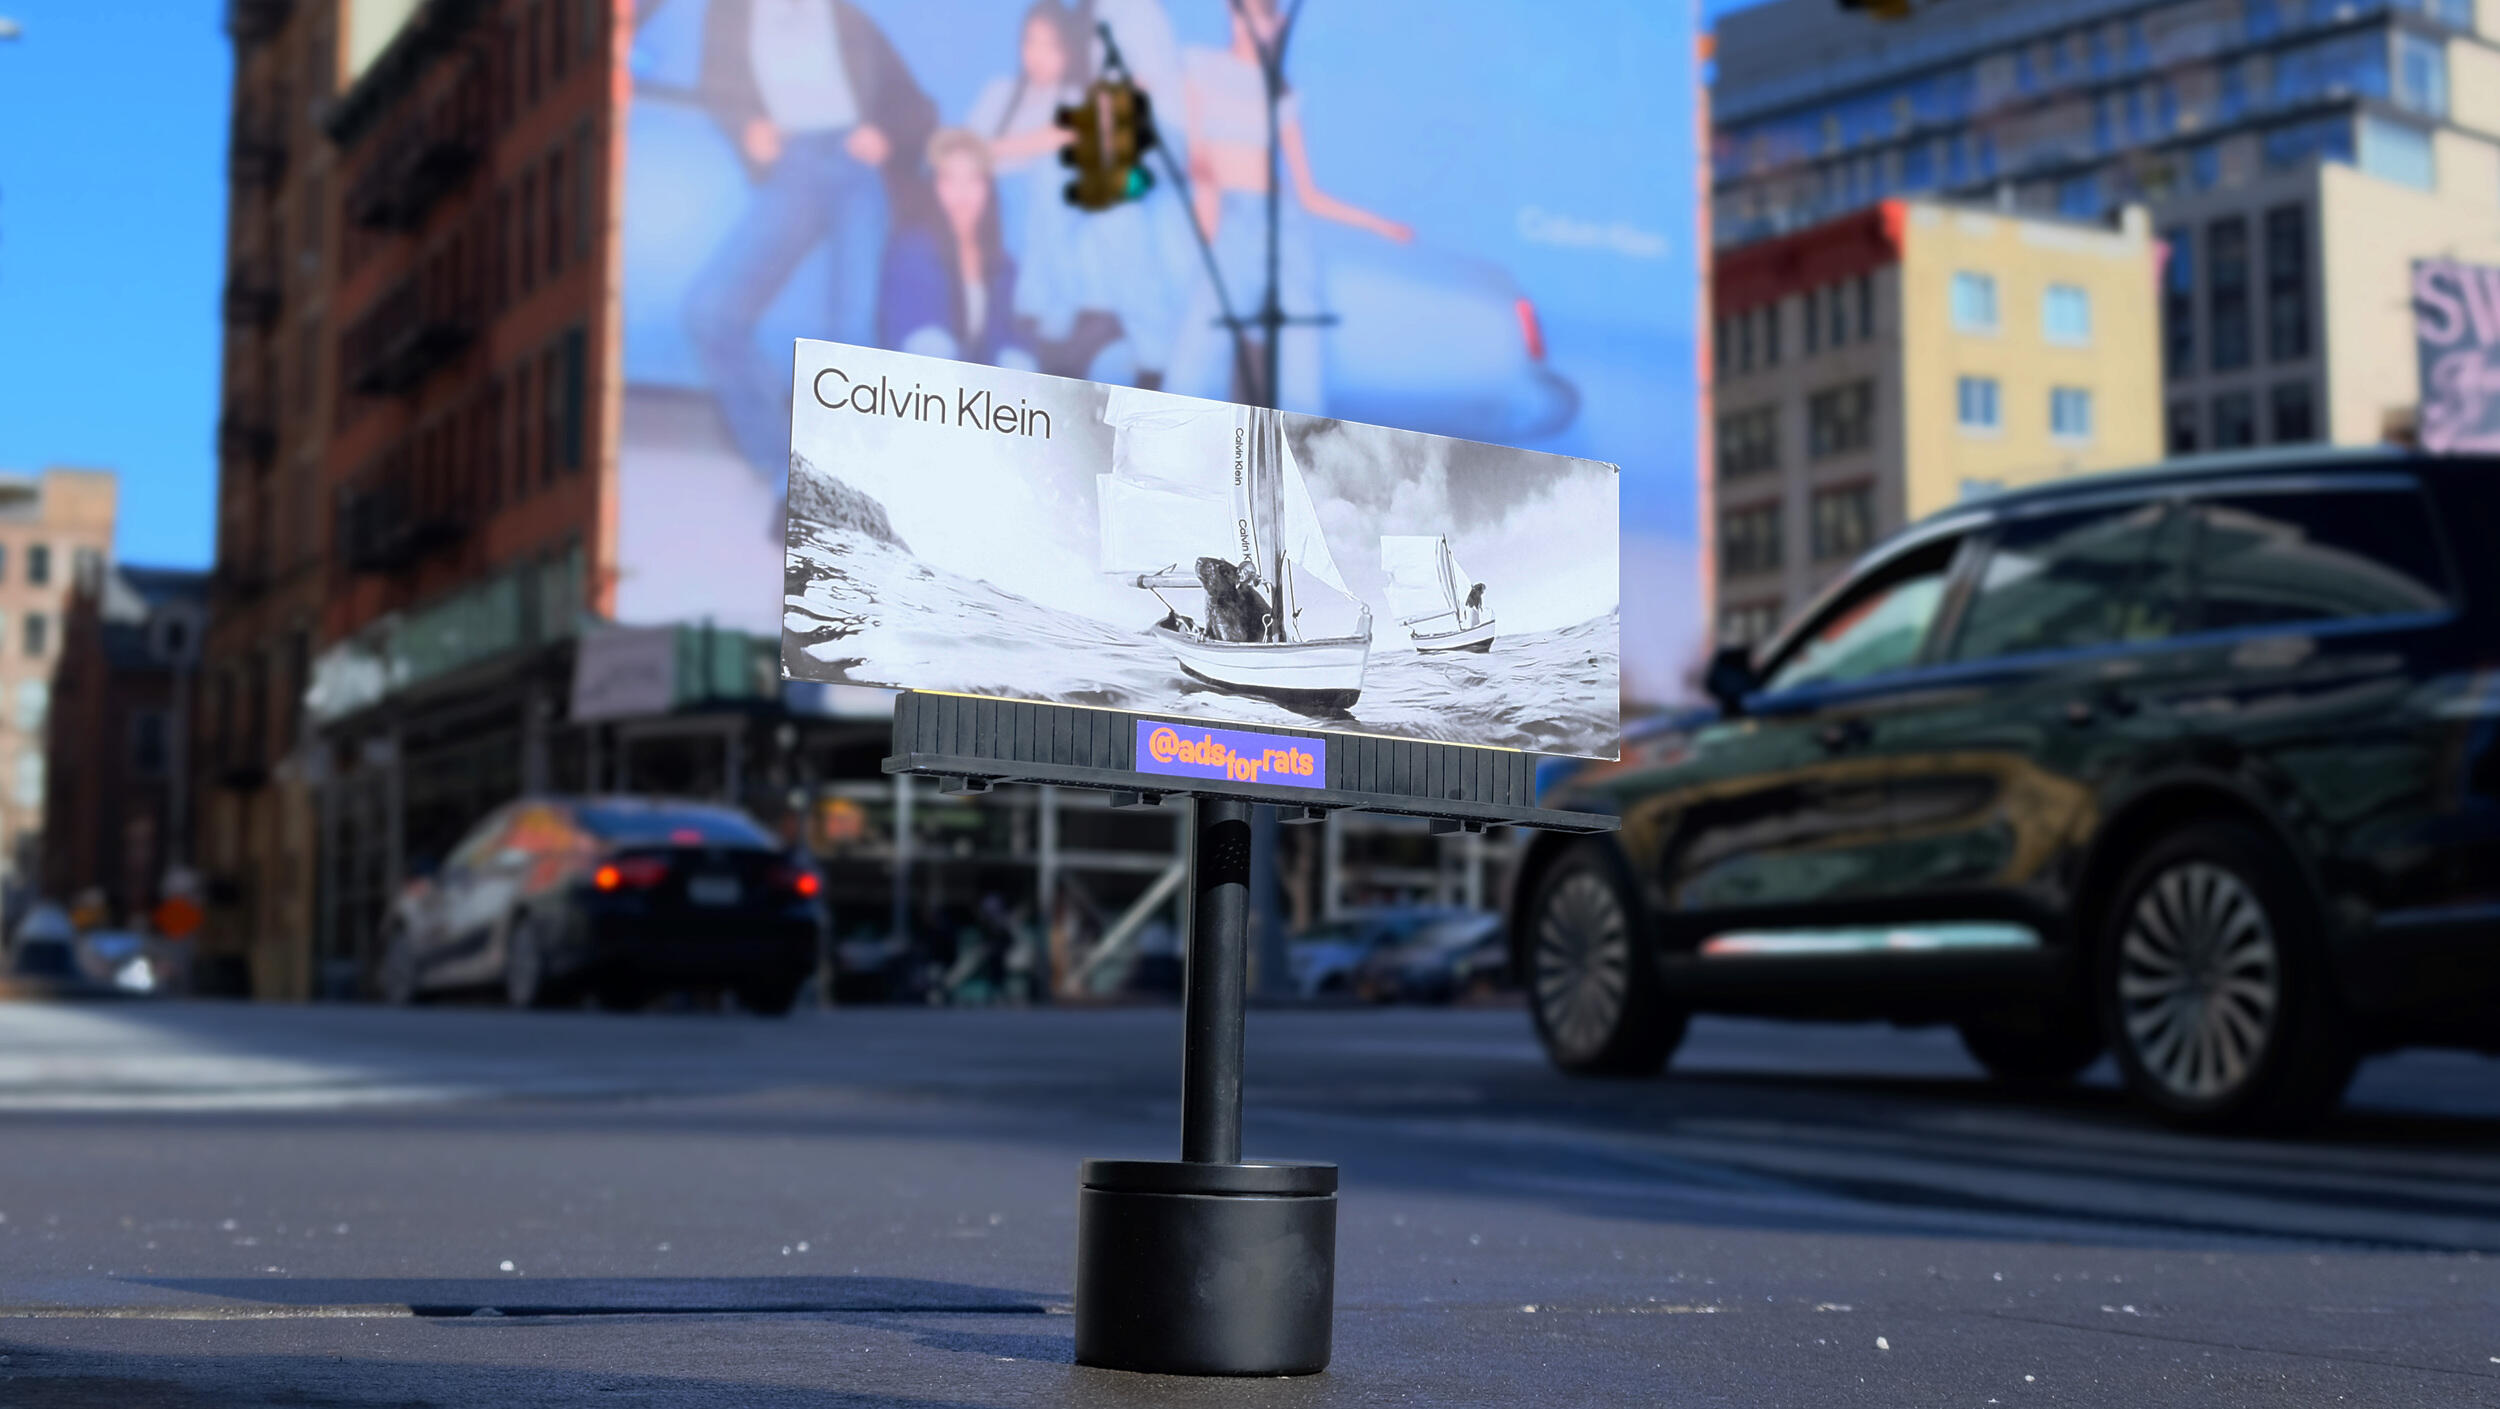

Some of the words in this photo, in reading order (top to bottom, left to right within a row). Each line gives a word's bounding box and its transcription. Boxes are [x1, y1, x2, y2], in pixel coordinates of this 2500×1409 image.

[813, 367, 946, 425] Calvin
[957, 387, 1051, 439] Klein
[1235, 427, 1244, 459] Calvin
[1234, 460, 1243, 486] Klein
[1238, 519, 1251, 552] Calvin
[1149, 727, 1315, 782] @adsforrats
